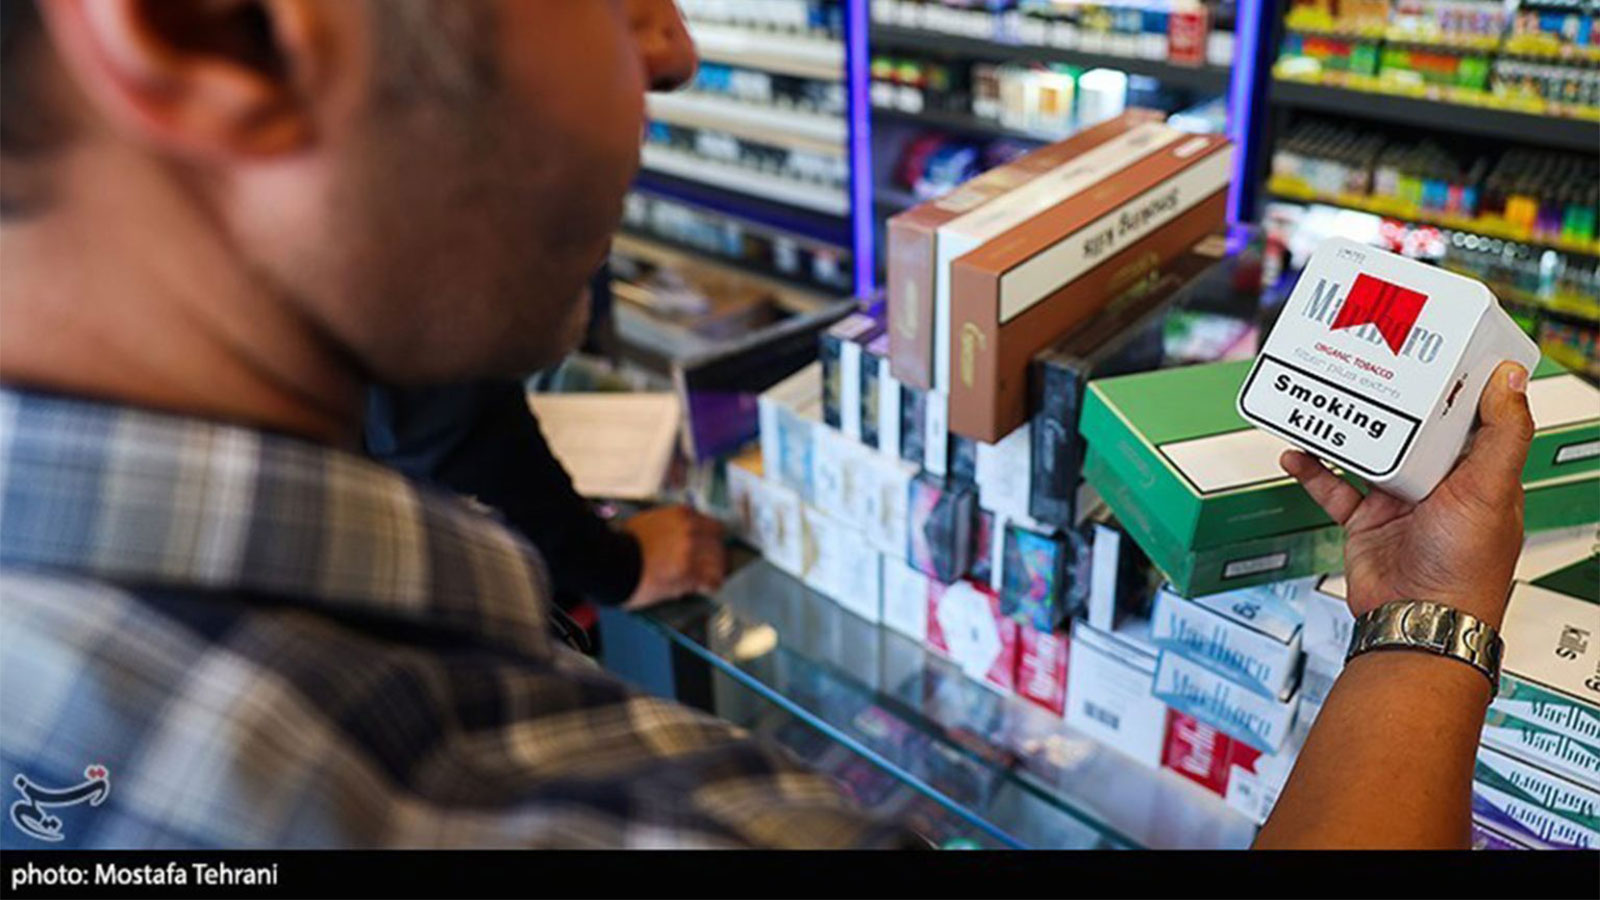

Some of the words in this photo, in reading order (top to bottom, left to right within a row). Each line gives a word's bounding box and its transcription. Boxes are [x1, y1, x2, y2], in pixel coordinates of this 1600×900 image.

[1353, 357, 1395, 380] TOBACCO
[1274, 374, 1388, 440] Smoking
[1288, 408, 1347, 447] kills
